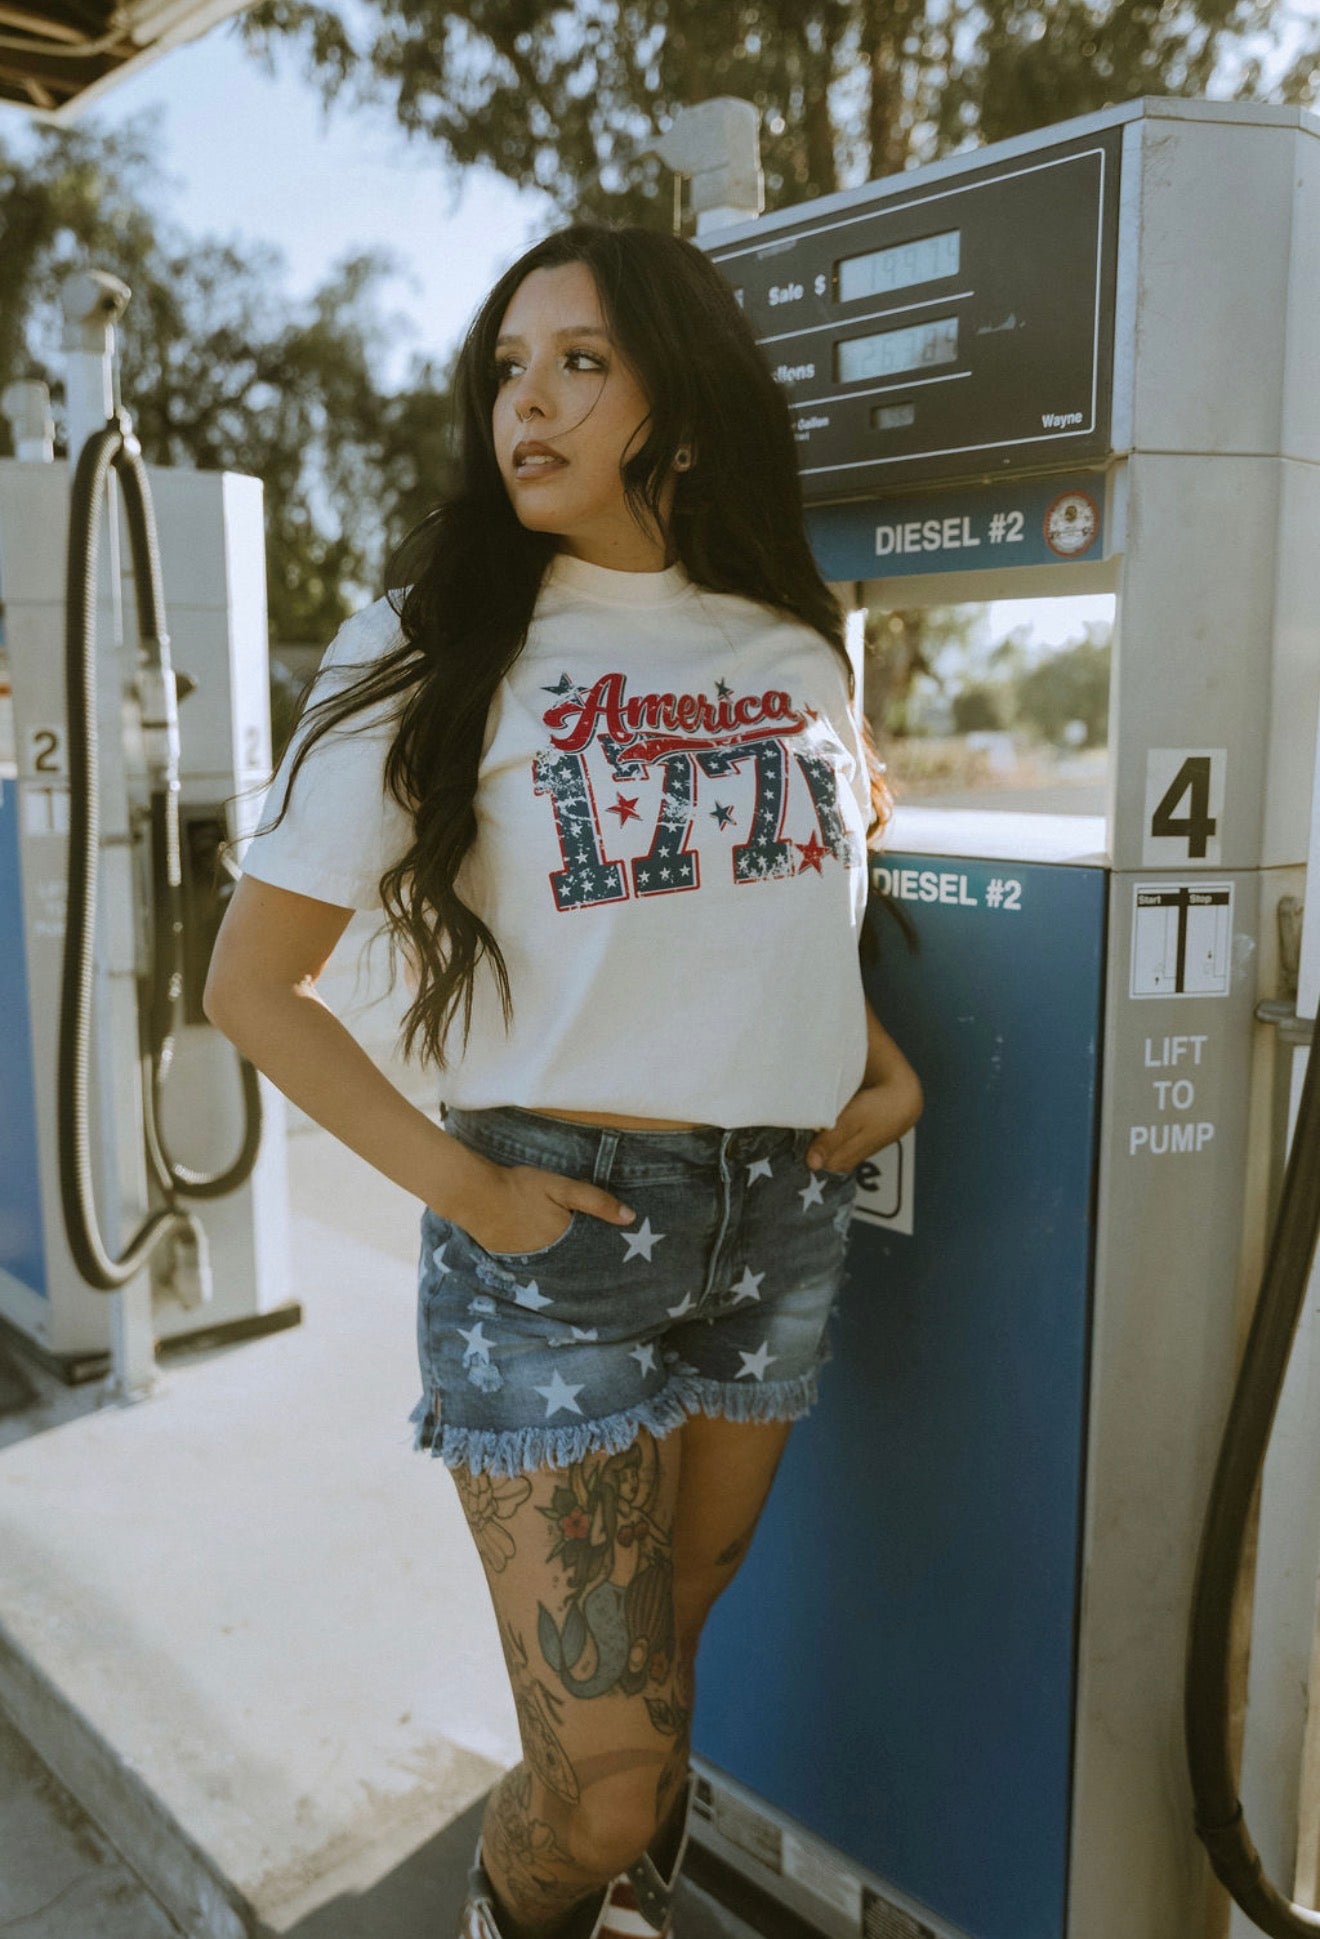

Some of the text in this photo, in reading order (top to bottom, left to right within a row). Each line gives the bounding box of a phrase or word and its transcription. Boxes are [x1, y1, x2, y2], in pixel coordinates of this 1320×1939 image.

[767, 283, 804, 306] Sale
[814, 274, 826, 296] $
[771, 364, 815, 383] llons
[1042, 412, 1083, 429] Wayne
[875, 516, 980, 556] DIESEL
[988, 511, 1024, 544] #2
[542, 673, 799, 753] America
[34, 730, 59, 772] 2
[1151, 756, 1217, 858] 4
[872, 868, 1022, 911] DIESEL #2
[1144, 1035, 1209, 1067] LIFT
[1152, 1078, 1195, 1111] TO
[1129, 1121, 1215, 1156] PUMP
